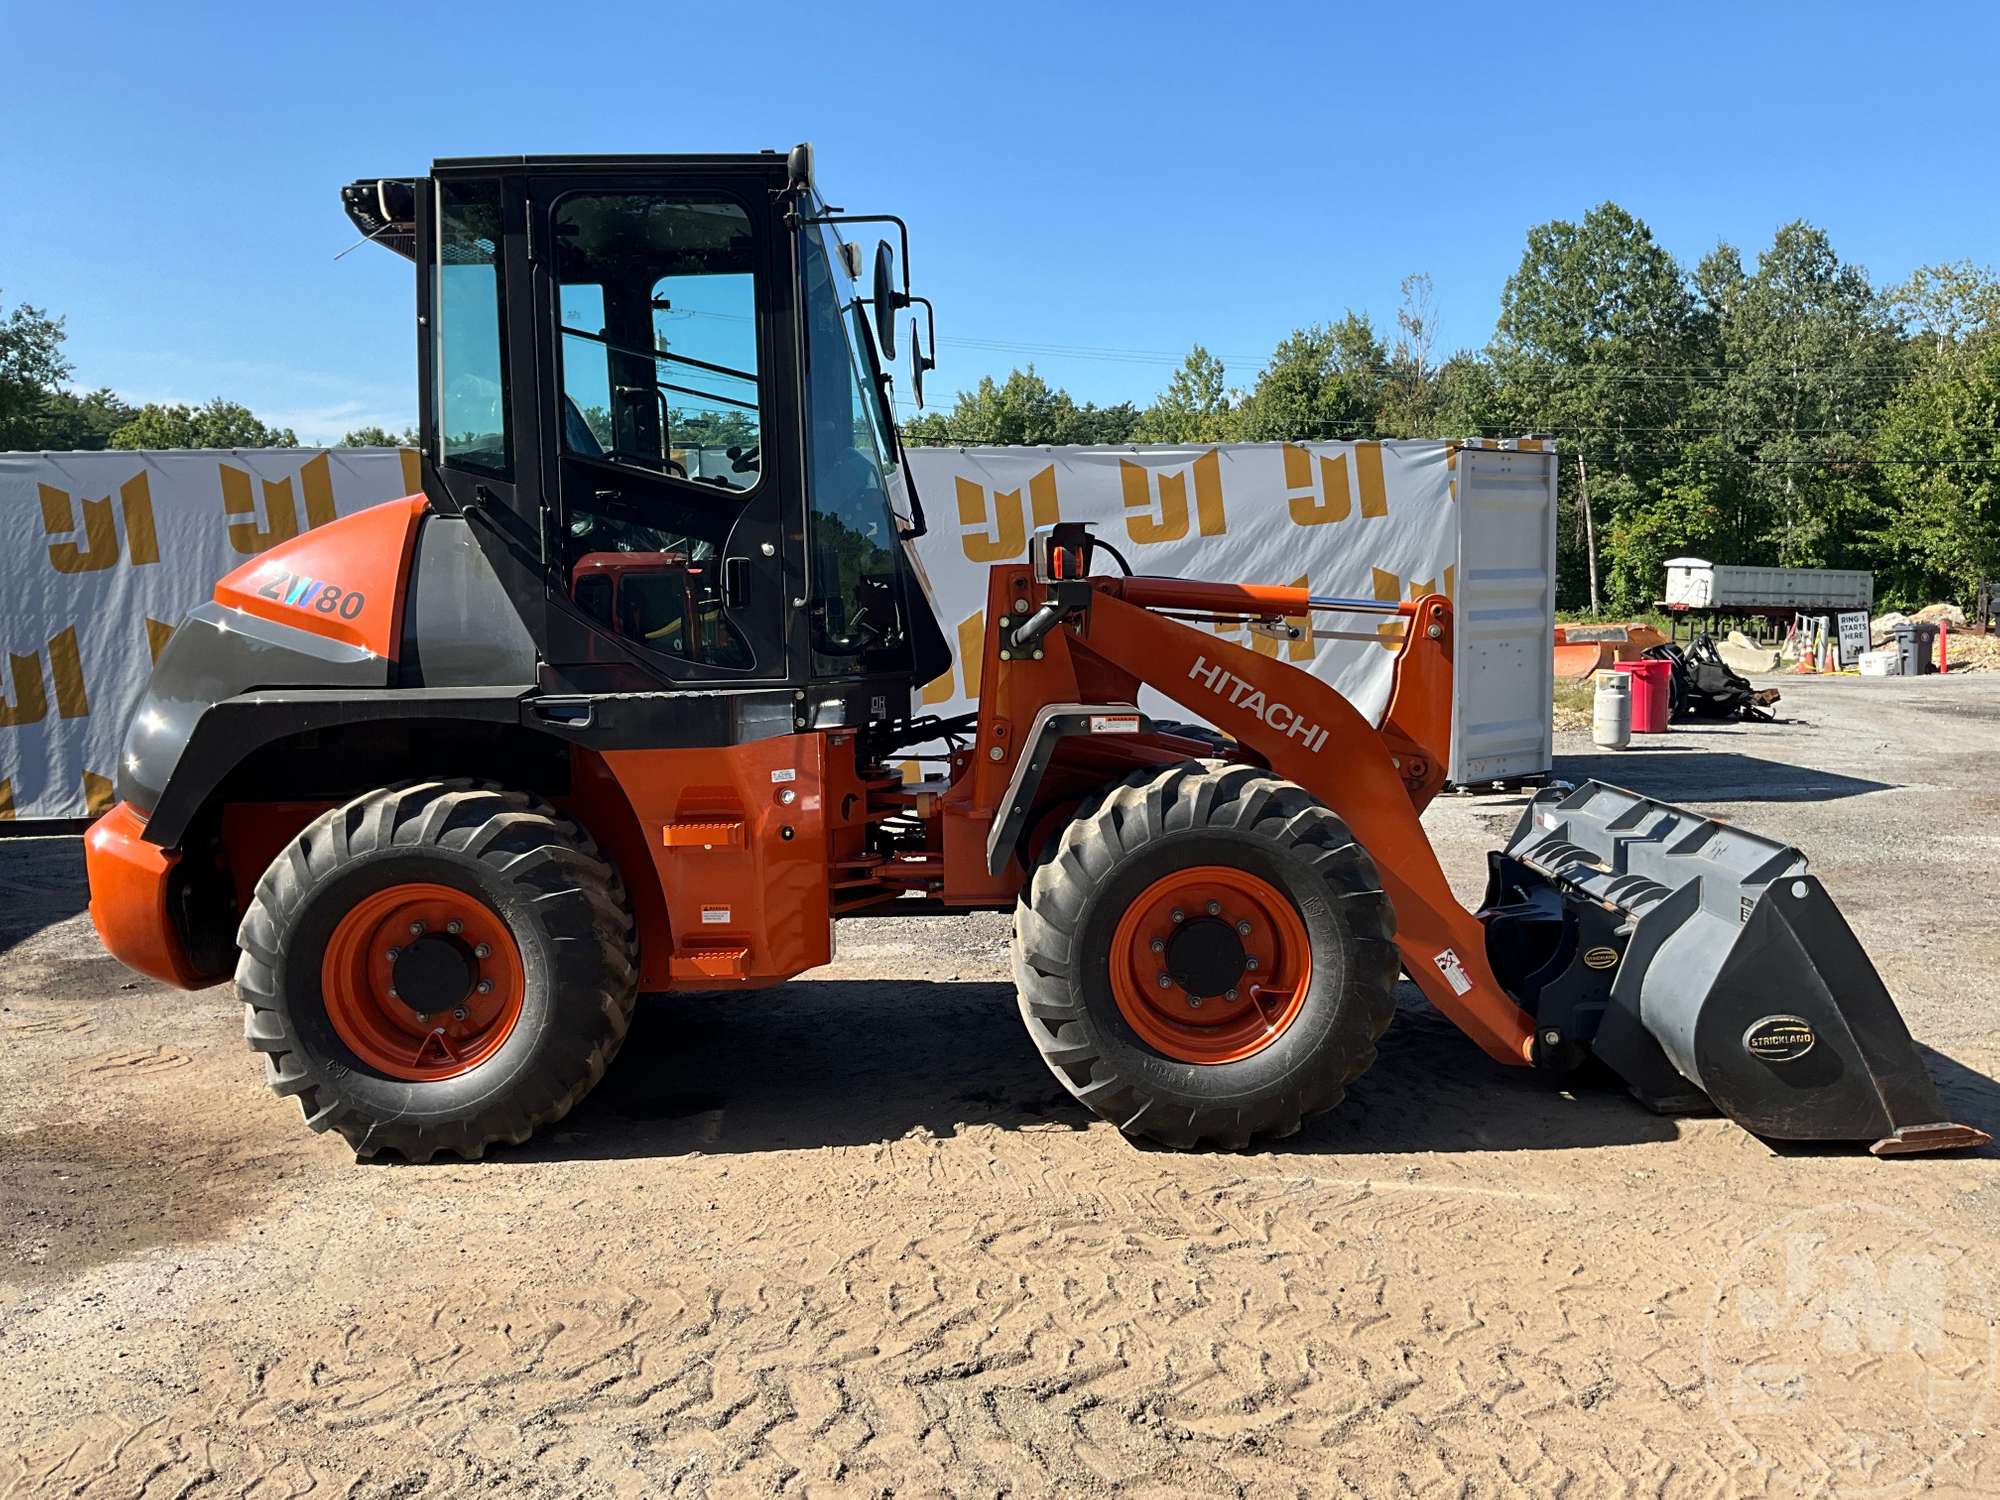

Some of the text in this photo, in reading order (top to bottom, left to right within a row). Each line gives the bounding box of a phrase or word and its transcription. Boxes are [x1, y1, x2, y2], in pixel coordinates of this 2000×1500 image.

[258, 571, 367, 620] ZW80
[1841, 616, 1859, 624] RING
[1840, 624, 1867, 632] STARTS
[1188, 655, 1330, 753] HITACHI
[1751, 1033, 1811, 1046] STRICKLAND
